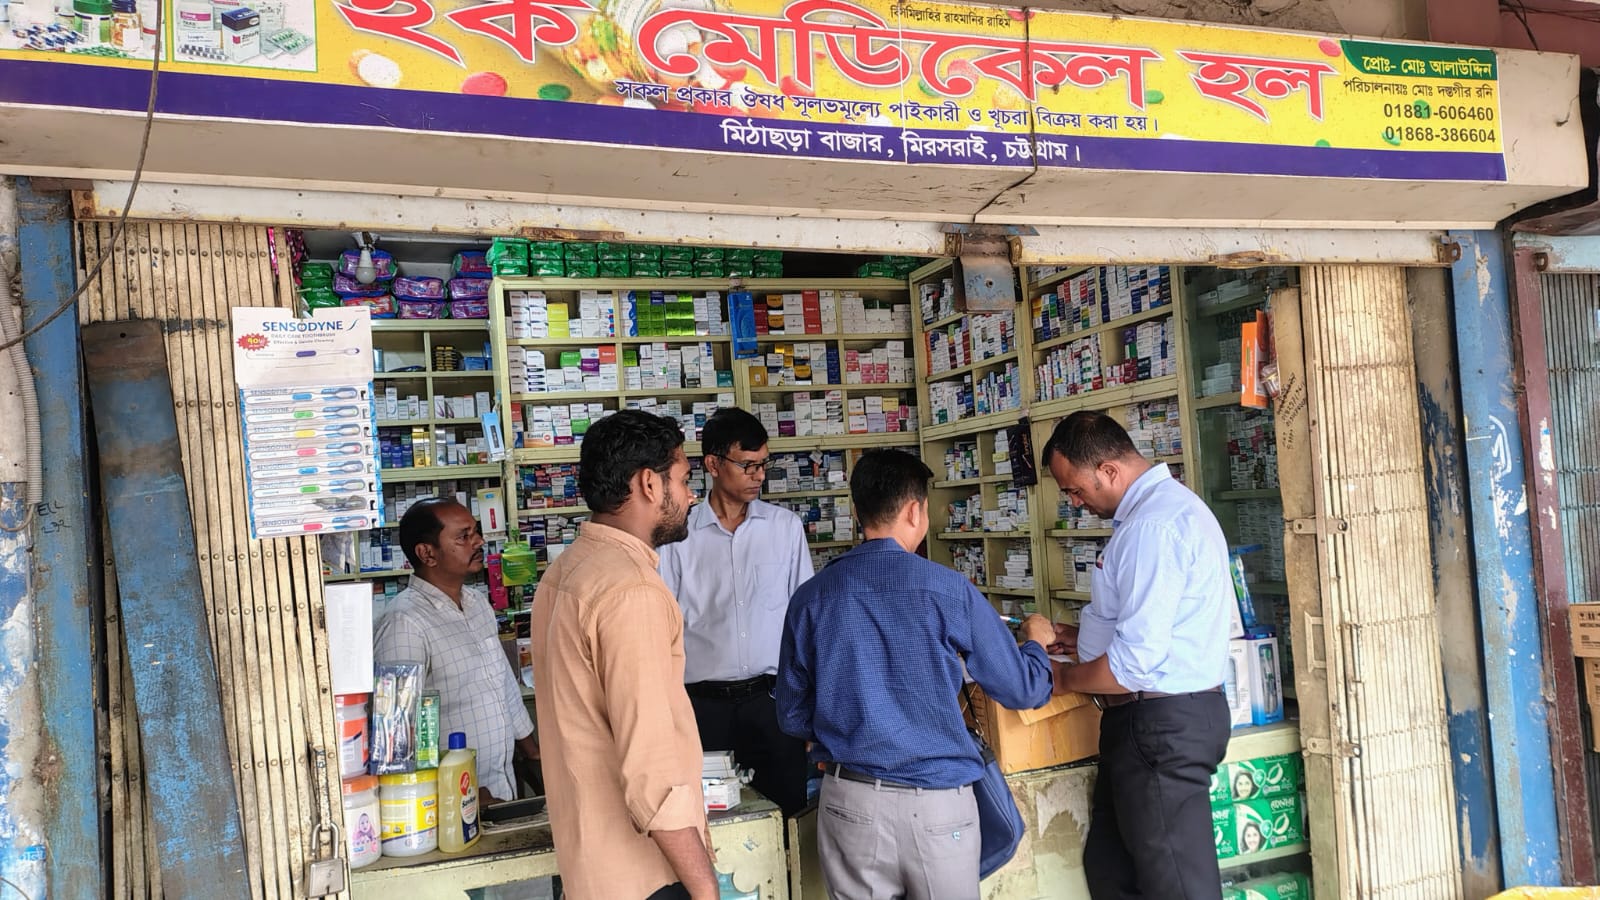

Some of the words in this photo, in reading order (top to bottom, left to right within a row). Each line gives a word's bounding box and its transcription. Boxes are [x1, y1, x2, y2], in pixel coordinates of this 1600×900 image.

[987, 14, 1011, 28] রাহিম
[636, 0, 1165, 111] মেডিকেল
[1177, 50, 1339, 123] হল
[1401, 58, 1426, 74] মোঃ
[1429, 58, 1492, 77] আলাউদ্দিন
[1412, 84, 1434, 97] মোঃ
[614, 79, 669, 102] সকল
[676, 85, 733, 107] প্রকার
[740, 86, 786, 111] ঔষধ
[888, 100, 961, 122] পাইকারী
[967, 108, 982, 122] ও
[1035, 106, 1082, 128] বিক্রয়
[1087, 113, 1119, 130] করা
[1384, 103, 1494, 122] 01881-606460
[719, 117, 812, 152] মিঠাছড়া
[1385, 126, 1496, 143] 01868-386604
[262, 320, 344, 333] SENSODYNE
